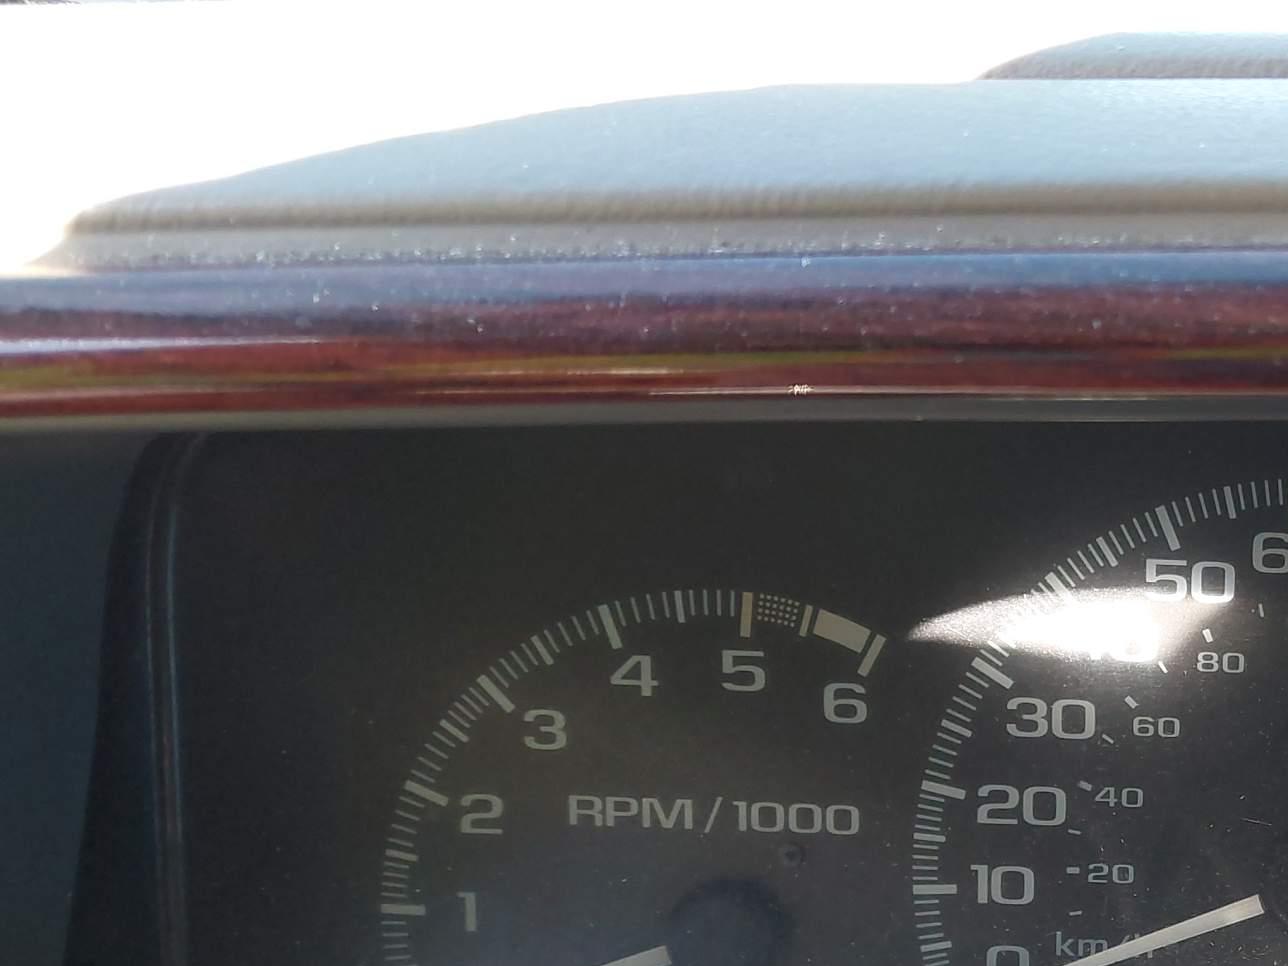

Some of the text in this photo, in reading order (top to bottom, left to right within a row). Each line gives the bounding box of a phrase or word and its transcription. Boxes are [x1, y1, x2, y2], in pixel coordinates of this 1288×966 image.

[1145, 559, 1235, 604] 50
[610, 655, 659, 696] 4
[722, 650, 766, 691] 5
[1196, 652, 1245, 673] 80
[823, 682, 868, 724] 6
[1006, 697, 1096, 740] 30
[523, 709, 567, 751] 3
[1132, 717, 1181, 738] 60
[459, 793, 504, 834] 2
[976, 785, 1067, 826] 20
[1094, 787, 1144, 808] 40
[970, 864, 1035, 905] 10
[1087, 864, 1135, 884] 20
[456, 892, 477, 932] 1
